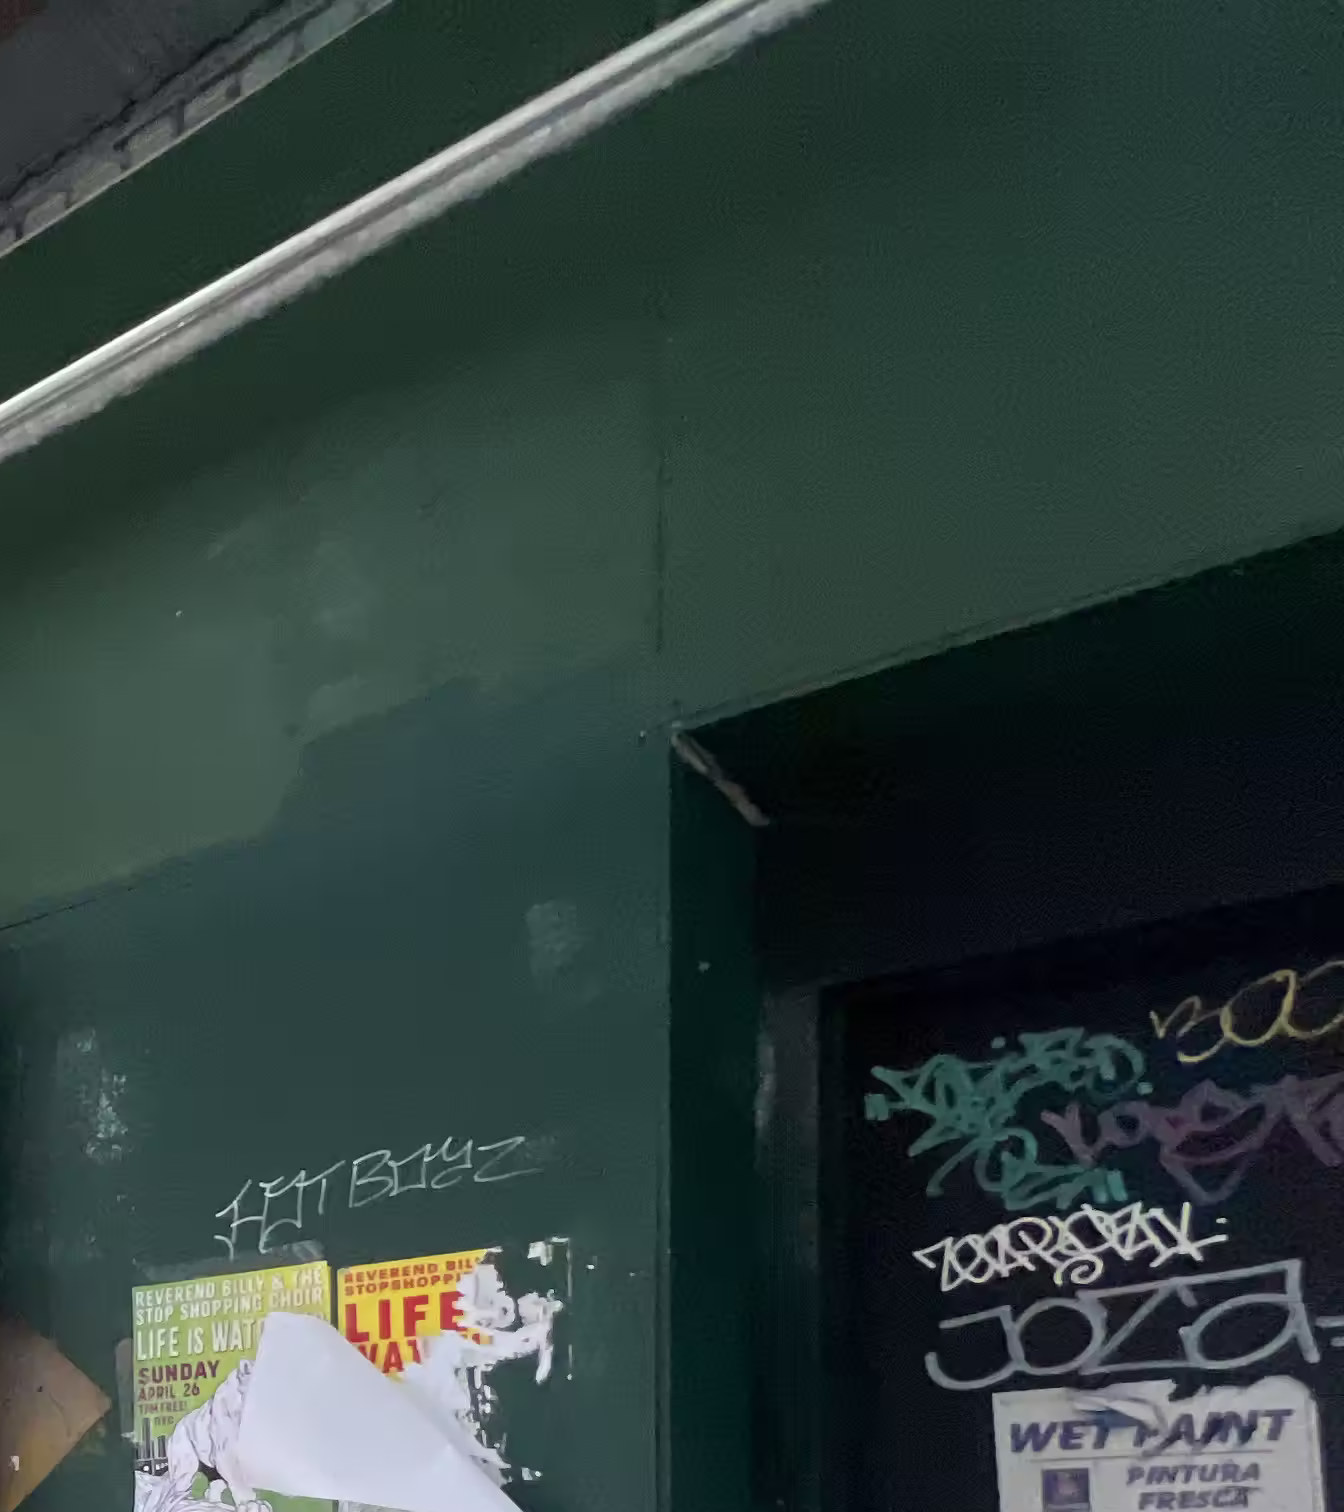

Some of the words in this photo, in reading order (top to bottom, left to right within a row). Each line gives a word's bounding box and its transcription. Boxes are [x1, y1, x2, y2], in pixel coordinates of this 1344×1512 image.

[135, 1281, 216, 1307] REVEREND
[222, 1273, 264, 1297] BILLY
[293, 1265, 322, 1289] THE
[344, 1263, 439, 1285] REVEREND
[344, 1272, 462, 1297] STOPSHOPPI
[136, 1304, 175, 1326] STOP
[179, 1294, 263, 1321] SHOPPING
[267, 1286, 323, 1308] CHOIR
[345, 1290, 465, 1344] LIFE
[137, 1325, 180, 1360] LIFE
[186, 1326, 205, 1356] IS
[211, 1318, 265, 1353] WAT
[138, 1360, 220, 1386] SUNDAY
[138, 1383, 176, 1401] APRIL
[183, 1382, 200, 1397] 26
[1010, 1419, 1113, 1454] WET
[1125, 1462, 1261, 1487] PINTURA
[1138, 1486, 1252, 1511] FRESCA
